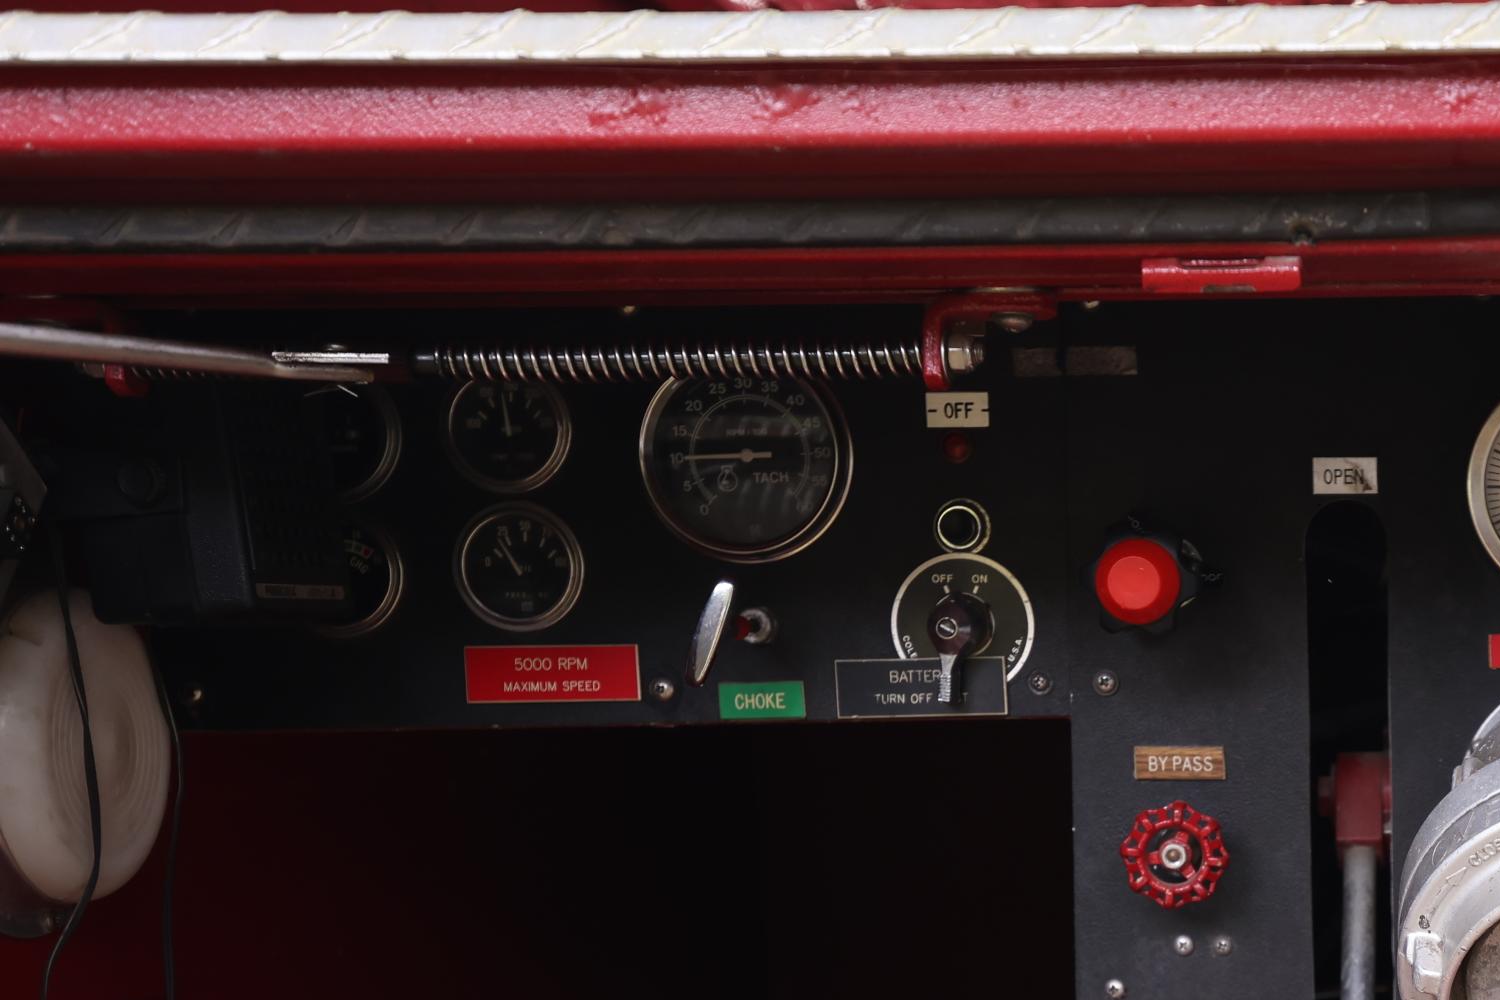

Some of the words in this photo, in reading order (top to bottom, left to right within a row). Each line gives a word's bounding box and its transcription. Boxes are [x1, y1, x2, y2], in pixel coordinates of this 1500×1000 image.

[709, 383, 727, 394] 25
[733, 378, 752, 390] 30
[761, 381, 779, 392] 35
[685, 400, 702, 412] 20
[943, 402, 974, 419] OFF
[672, 425, 687, 437] 15
[670, 453, 684, 464] 10
[753, 472, 790, 484] TACH
[1323, 468, 1365, 485] OPEN
[931, 573, 954, 584] OFF
[971, 574, 988, 584] ON
[514, 657, 551, 671] 5000
[558, 657, 588, 671] RPM
[889, 669, 948, 684] BATTER
[503, 681, 557, 693] MAXIMUM
[563, 680, 601, 692] SPEED
[734, 692, 786, 710] CHOKE
[874, 693, 906, 705] TURN
[910, 692, 933, 705] OFF
[1148, 755, 1168, 772] BY
[1172, 755, 1213, 772] PASS
